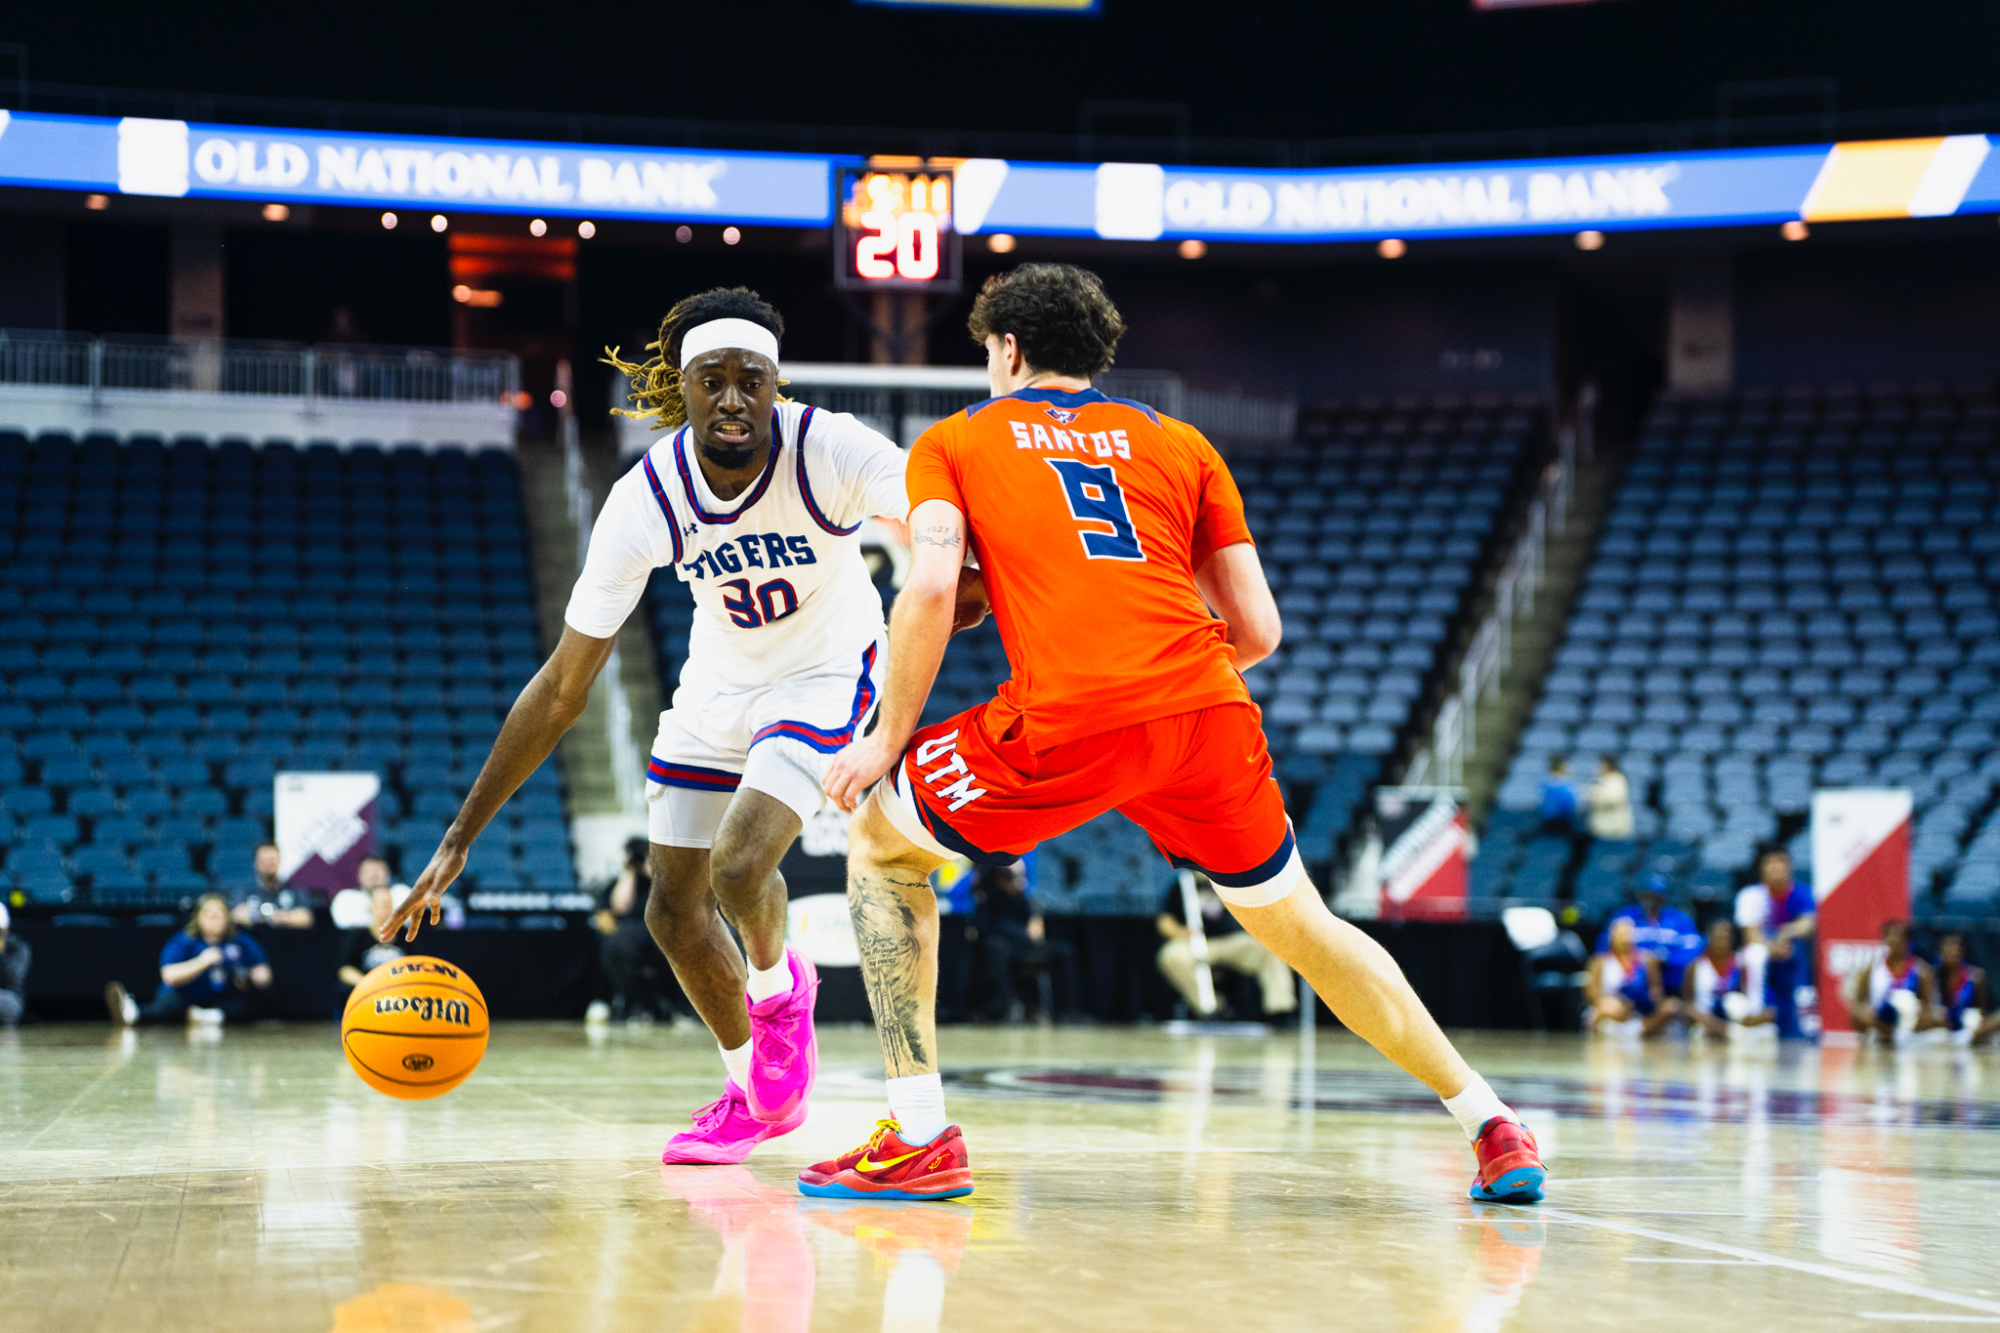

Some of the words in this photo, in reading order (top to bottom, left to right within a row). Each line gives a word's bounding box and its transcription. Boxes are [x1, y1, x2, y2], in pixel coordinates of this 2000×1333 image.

[195, 138, 310, 188] OLD
[317, 144, 575, 201] NATIONAL
[579, 157, 720, 209] BANK
[1165, 179, 1272, 228] OLD
[1275, 173, 1525, 228] NATIONAL
[1528, 167, 1673, 220] BANK
[855, 211, 939, 280] 20
[1008, 420, 1132, 460] SANTOS
[1042, 457, 1147, 562] 9
[682, 532, 817, 580] TIGERS
[716, 577, 799, 630] 30
[916, 727, 988, 813] UTM
[374, 996, 471, 1028] Wilson
